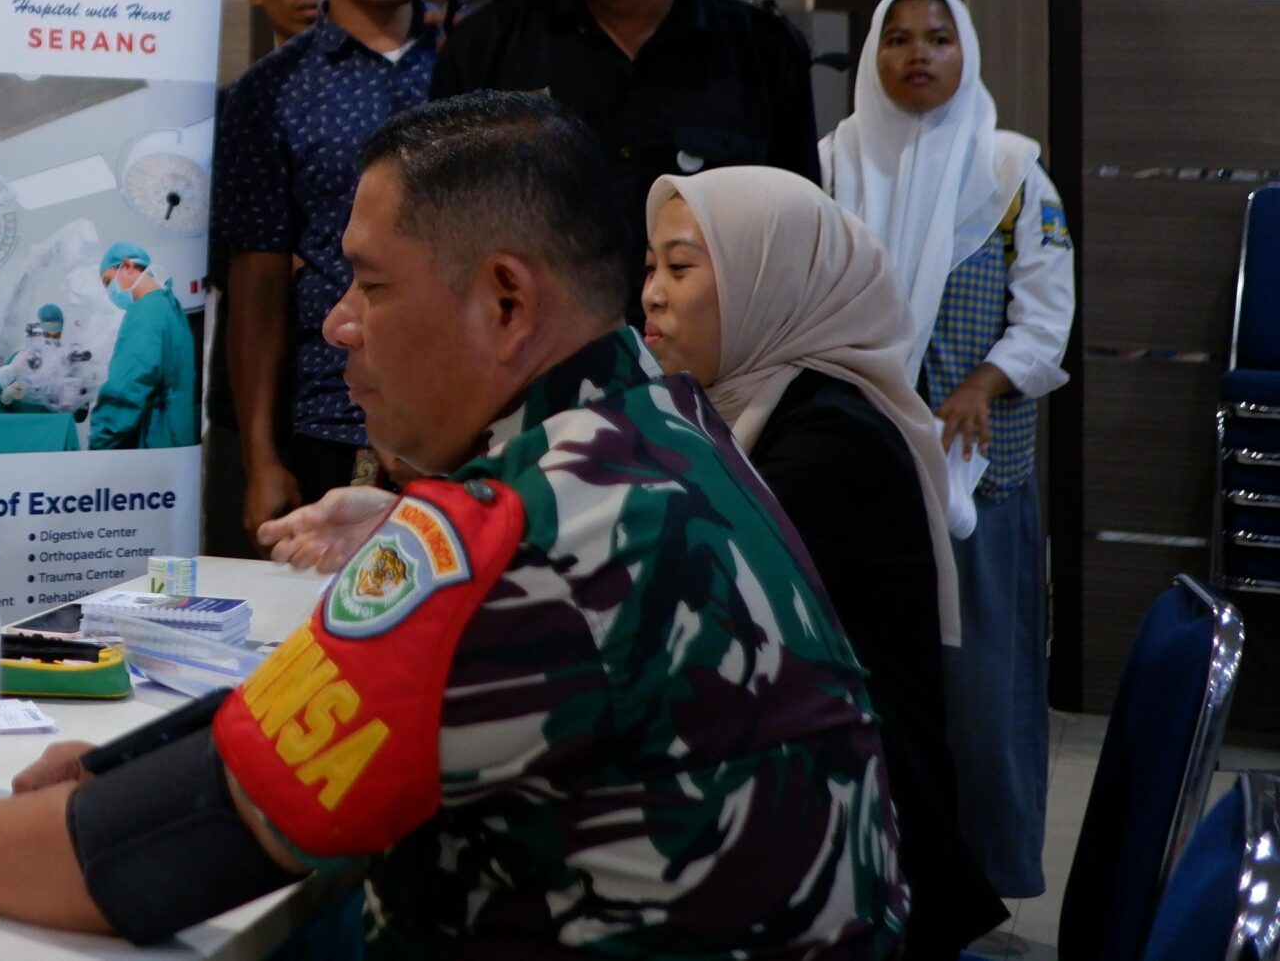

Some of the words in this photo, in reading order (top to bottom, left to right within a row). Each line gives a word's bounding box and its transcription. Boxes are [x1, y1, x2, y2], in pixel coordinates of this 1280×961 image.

[85, 3, 119, 19] with
[125, 3, 171, 22] Heart
[27, 27, 157, 54] SERANG
[27, 487, 177, 516] Excellence
[40, 527, 94, 543] Digestive
[97, 527, 138, 539] Center
[39, 547, 113, 562] Orthopaedic
[115, 547, 156, 558] Center
[39, 571, 82, 583] Trauma
[85, 569, 126, 580] Center
[243, 623, 390, 812] INSA
